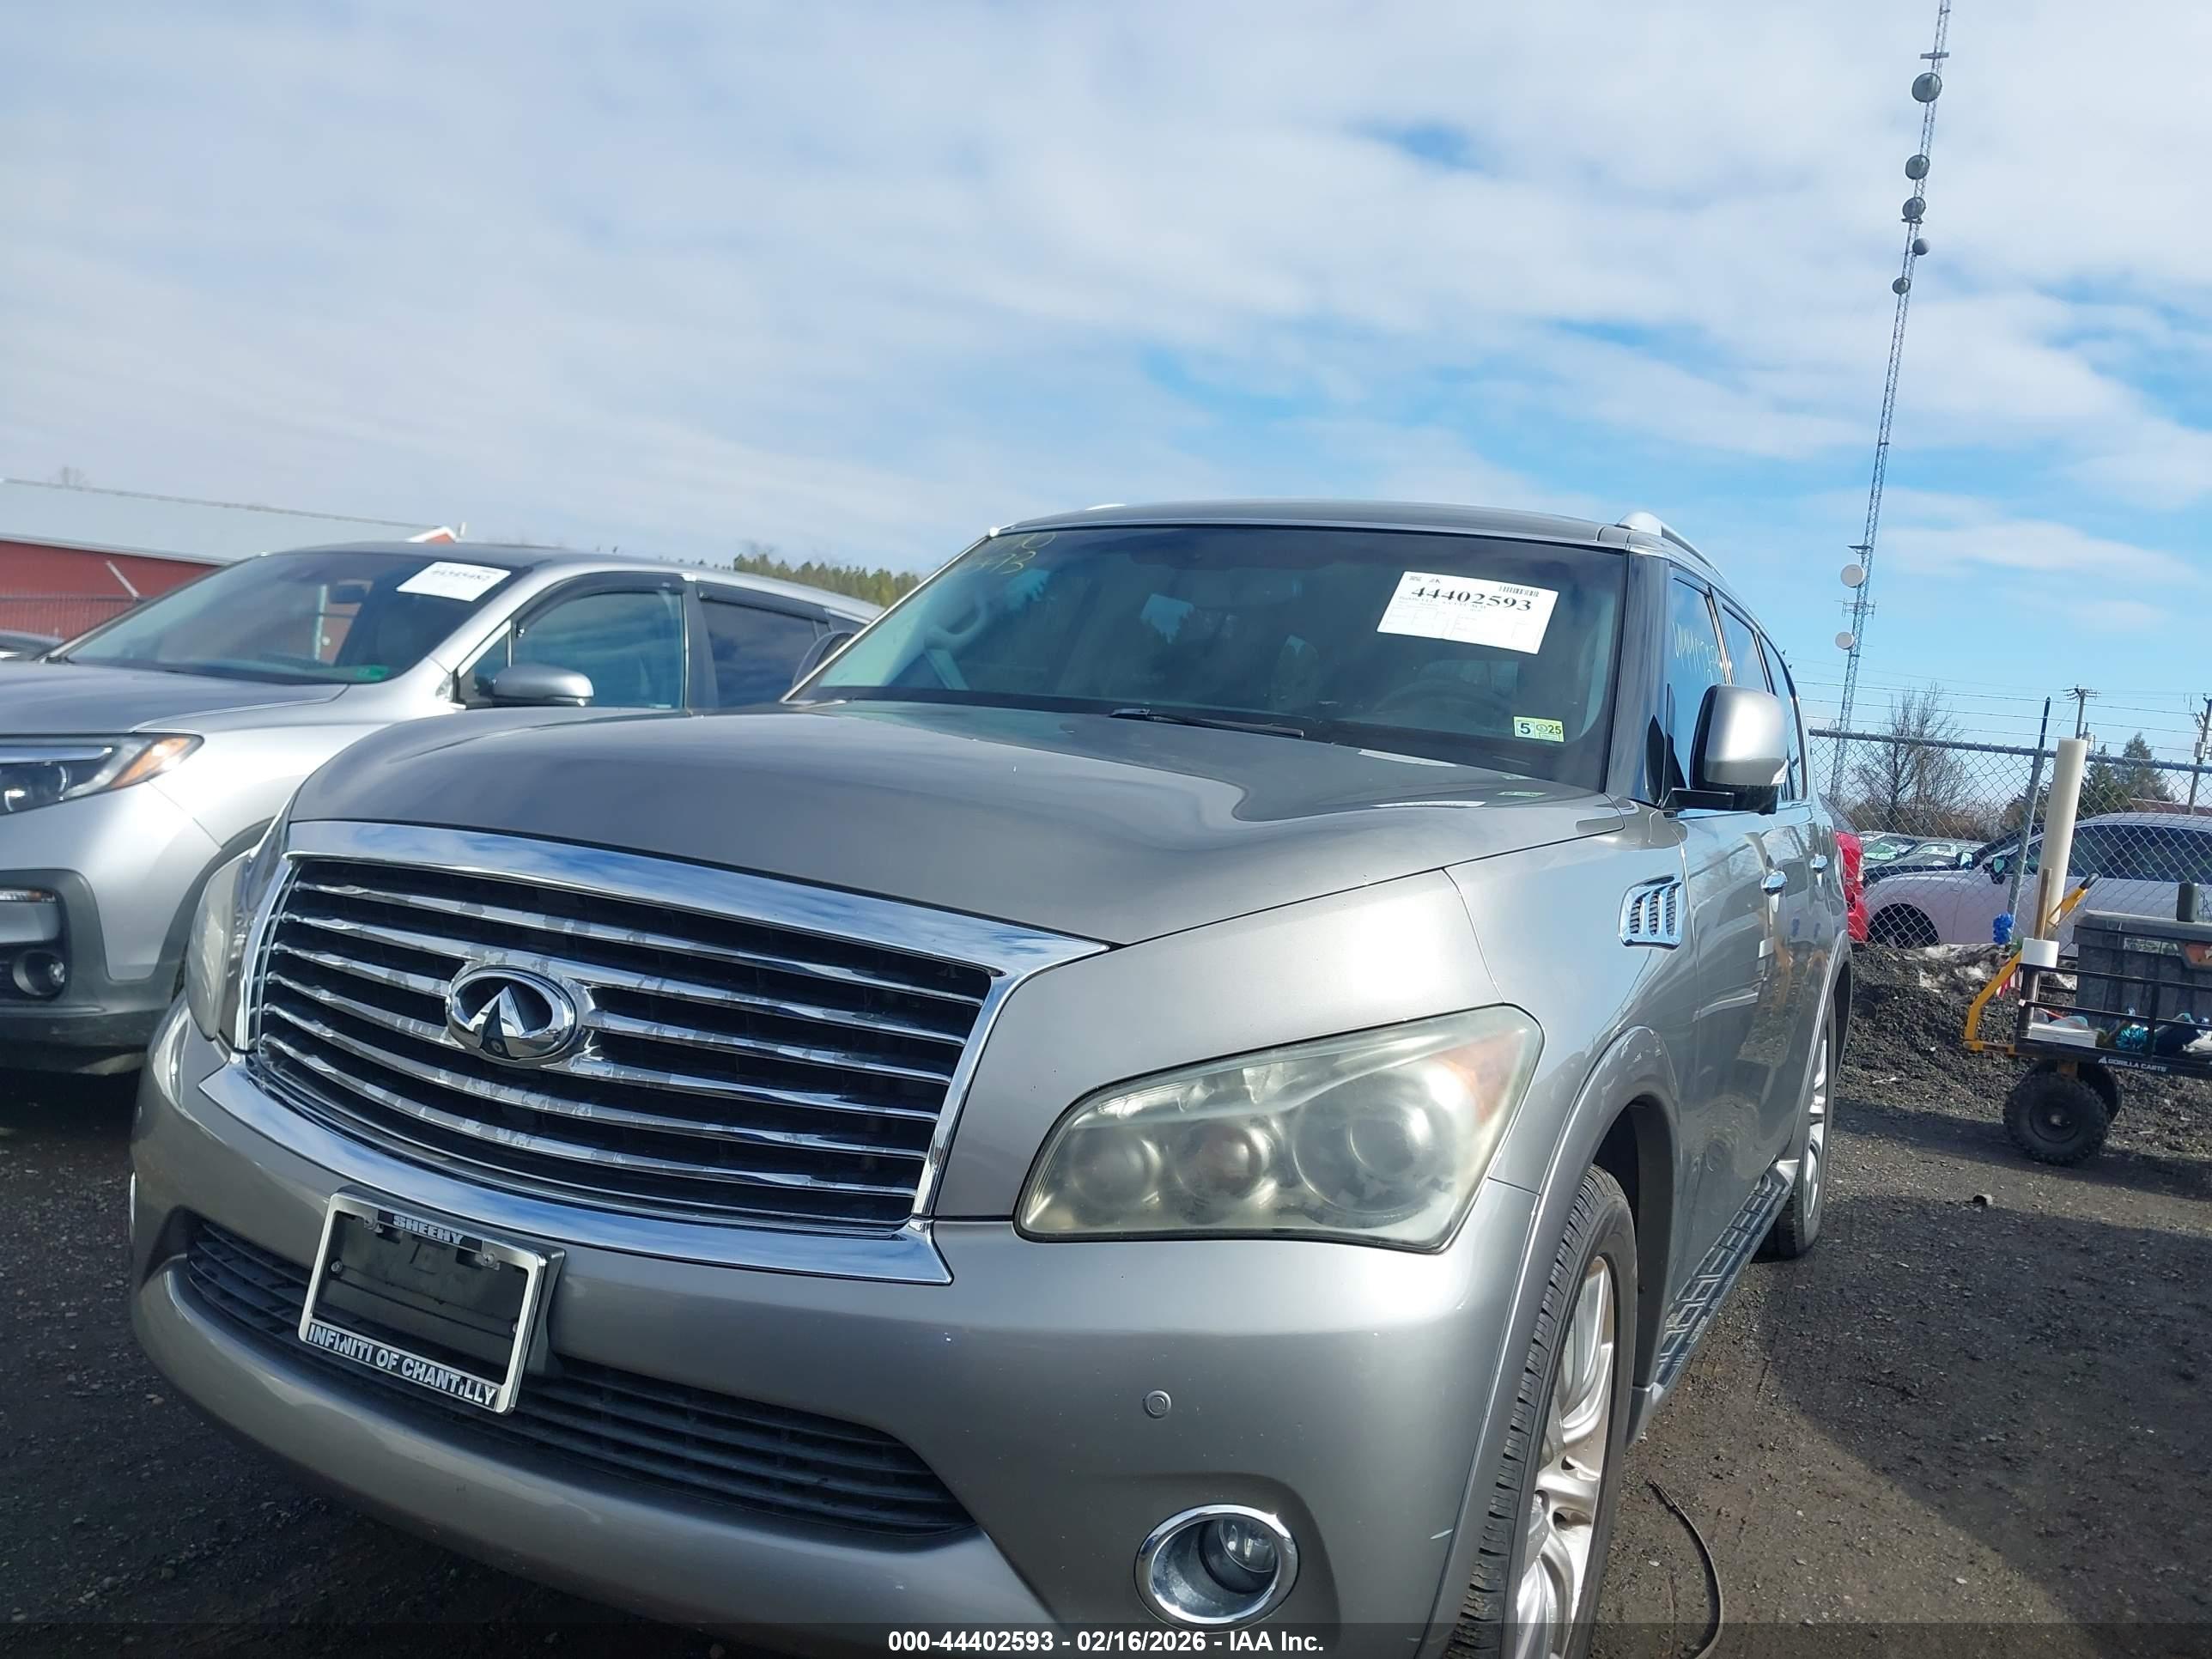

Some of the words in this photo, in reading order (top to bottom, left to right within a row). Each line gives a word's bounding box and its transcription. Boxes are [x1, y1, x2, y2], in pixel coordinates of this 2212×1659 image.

[1411, 586, 1532, 611] 44402593
[1520, 722, 1531, 734] 5
[1548, 724, 1562, 735] 25
[392, 1214, 465, 1246] SHEEHY
[307, 1323, 374, 1363] INFINITI
[375, 1349, 399, 1371] OF
[401, 1358, 498, 1407] CHANTILLY
